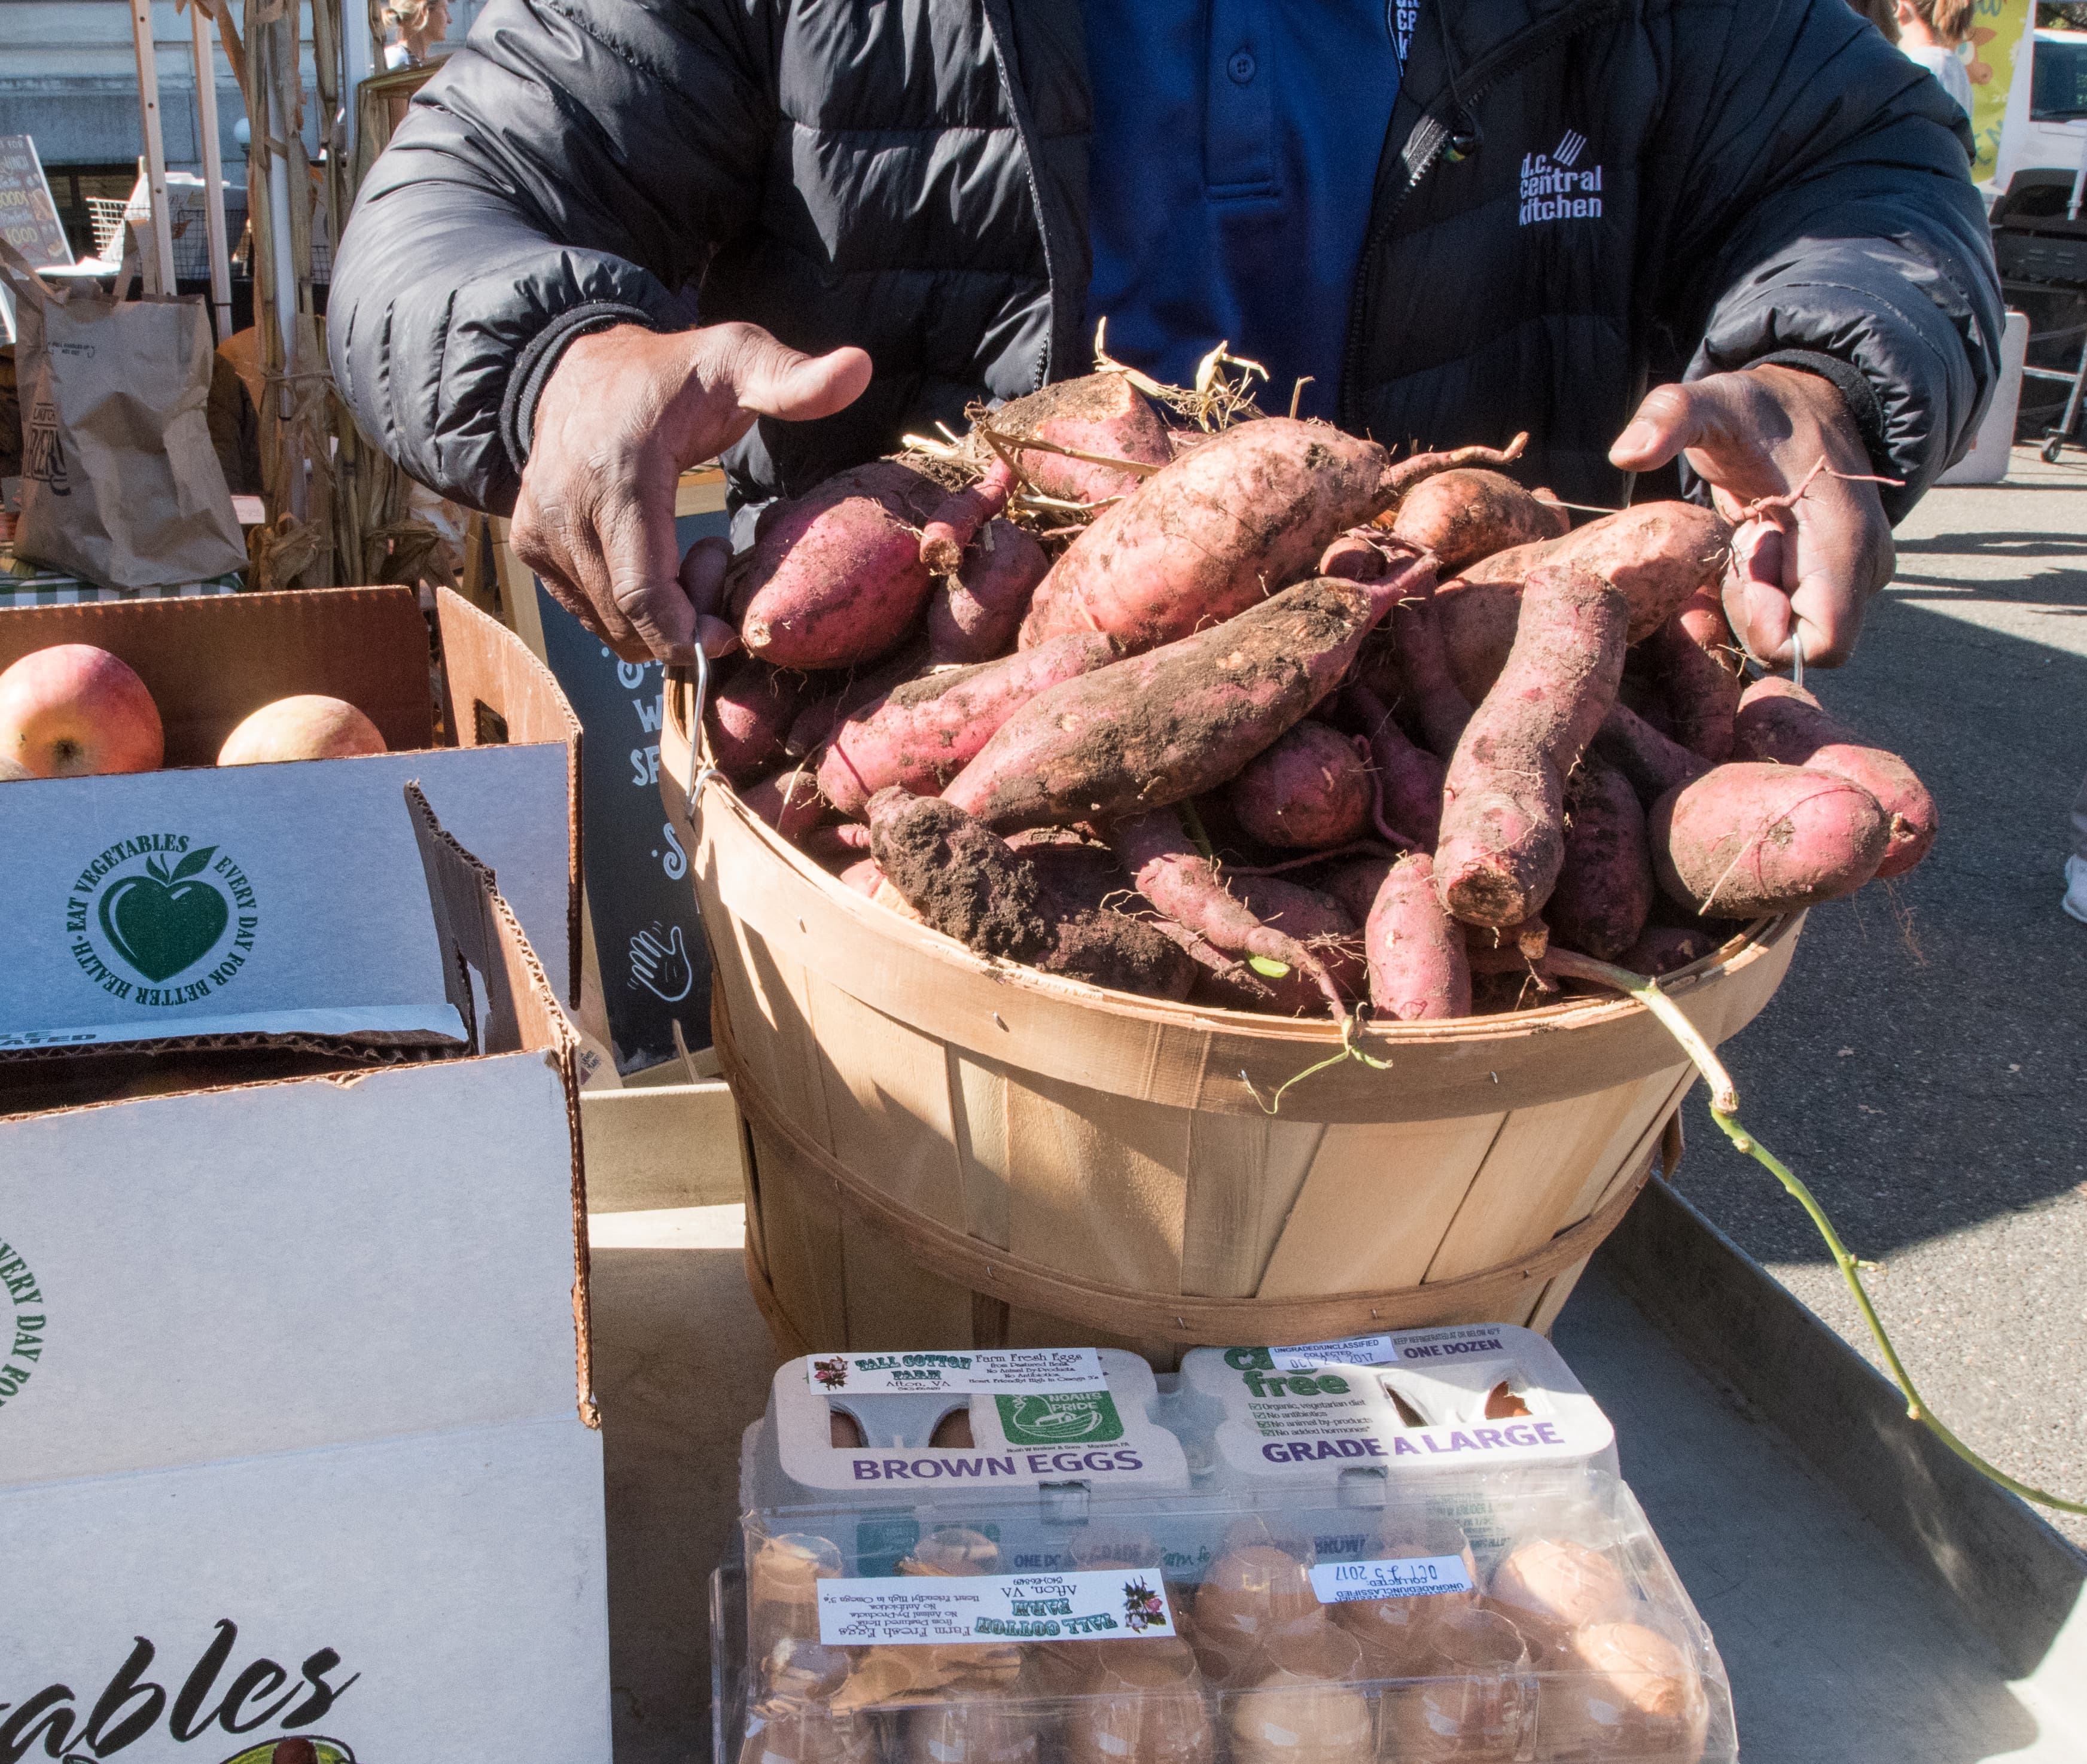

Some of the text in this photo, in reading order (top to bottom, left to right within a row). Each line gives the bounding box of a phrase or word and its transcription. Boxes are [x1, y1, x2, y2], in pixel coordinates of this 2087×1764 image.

[1521, 153, 1552, 178] d.c.
[1520, 165, 1601, 199] central
[1519, 194, 1601, 226] kitchen
[66, 833, 258, 1006] EAT VEGETABLES EVERY DAY FOR BETTER HEALTH
[0, 1237, 47, 1407] VERY DAY FO
[1409, 1333, 1449, 1343] REFRIGERATED
[1466, 1329, 1486, 1338] BELOW
[1274, 1339, 1379, 1353] UNGRADED/UNCLASSIFIED
[1404, 1339, 1503, 1358] ONE DOZEN
[854, 1354, 973, 1371] TALL COTTON
[1010, 1354, 1047, 1362] Fresh
[1052, 1352, 1083, 1363] Eggs
[1349, 1353, 1374, 1364] 2017
[891, 1370, 942, 1381] FARM
[1242, 1370, 1351, 1397] free
[1051, 1402, 1098, 1412] PRIDE
[1301, 1400, 1348, 1409] vegetarian
[1318, 1416, 1373, 1427] by-products
[1262, 1422, 1566, 1463] GRADE A LARGE
[853, 1450, 1143, 1480] BROWN EGGS
[1336, 1565, 1367, 1580] 2017
[888, 1594, 907, 1602] High
[1001, 1585, 1077, 1598] Afton, VA
[1336, 1583, 1464, 1597] UNGRADED/UNCLASSIFIED
[1011, 1598, 1073, 1616] FARM
[839, 1624, 971, 1638] Farm Fresh Eggs
[974, 1613, 1119, 1637] TALL COTTON
[0, 1619, 361, 1764] ables
